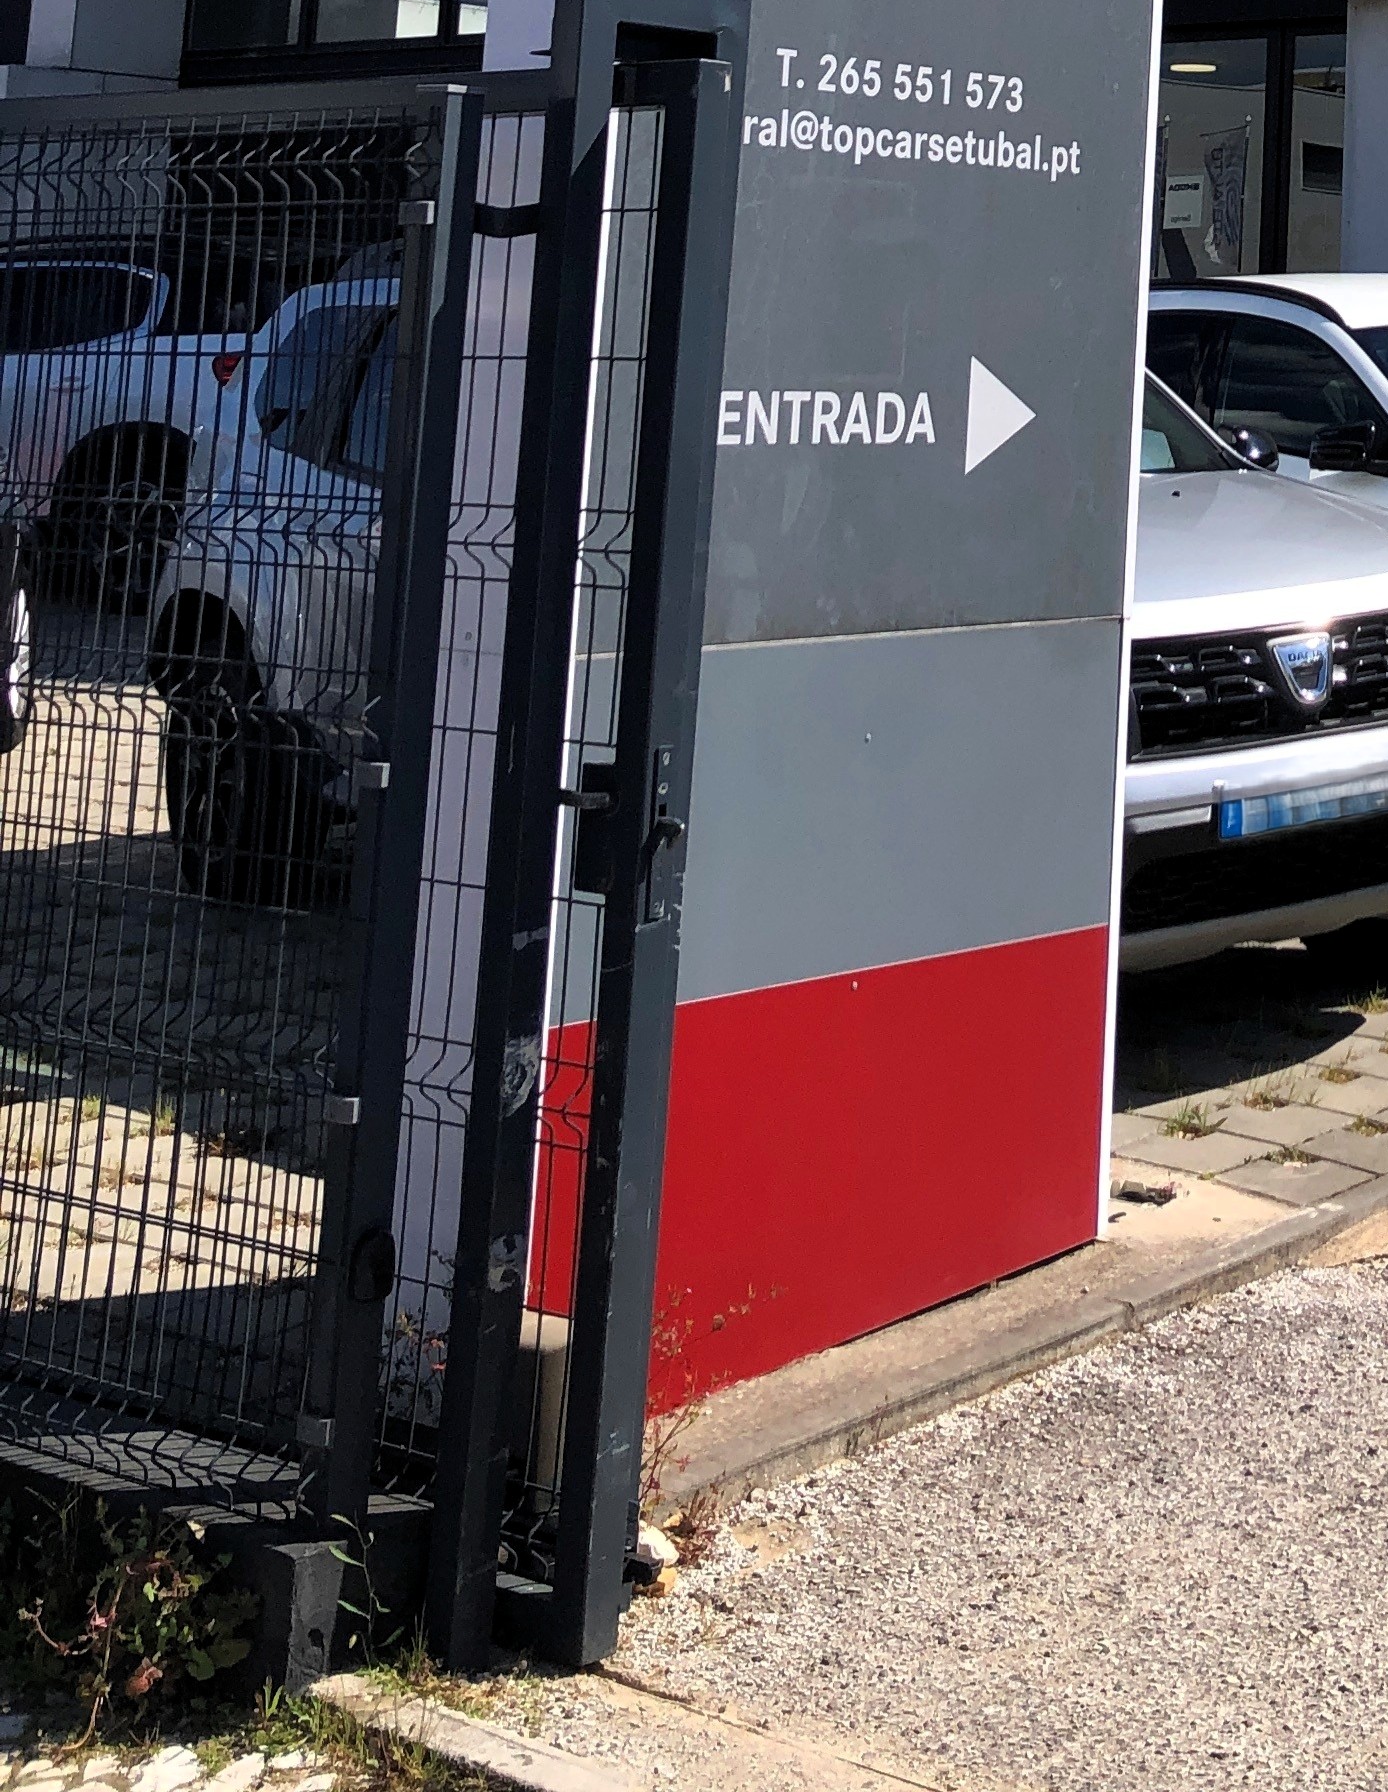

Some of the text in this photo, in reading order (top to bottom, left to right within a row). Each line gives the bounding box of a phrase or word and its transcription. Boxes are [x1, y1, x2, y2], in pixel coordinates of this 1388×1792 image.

[776, 47, 1023, 113] T. 265 551 573
[743, 109, 1081, 182] ral@topcarsetubal.pt
[716, 390, 936, 446] ENTRADA
